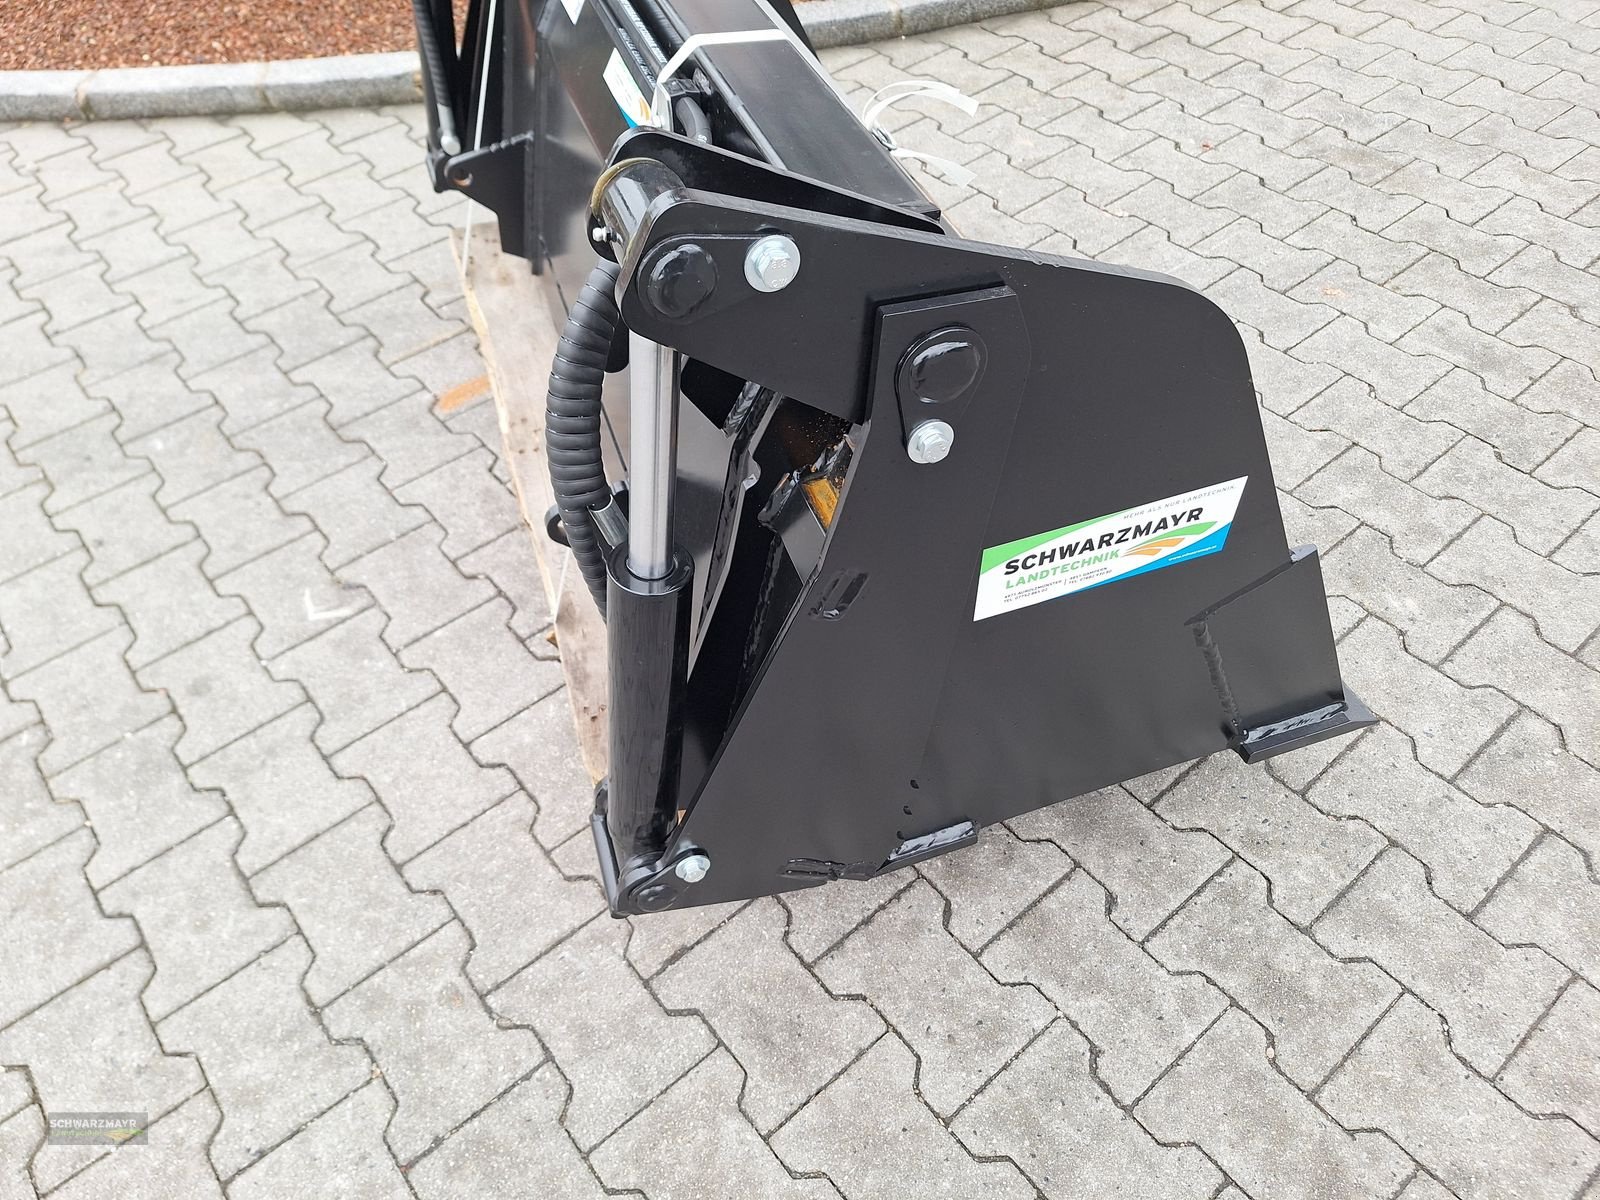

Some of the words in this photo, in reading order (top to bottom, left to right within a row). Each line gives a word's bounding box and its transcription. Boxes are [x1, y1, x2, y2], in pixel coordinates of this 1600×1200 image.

[1123, 510, 1145, 520] MEHR
[1147, 504, 1162, 513] ALS
[1164, 499, 1180, 508] NUR
[1004, 507, 1205, 575] SCHWARZMAYR
[1005, 549, 1120, 589] LANDTECHNIK
